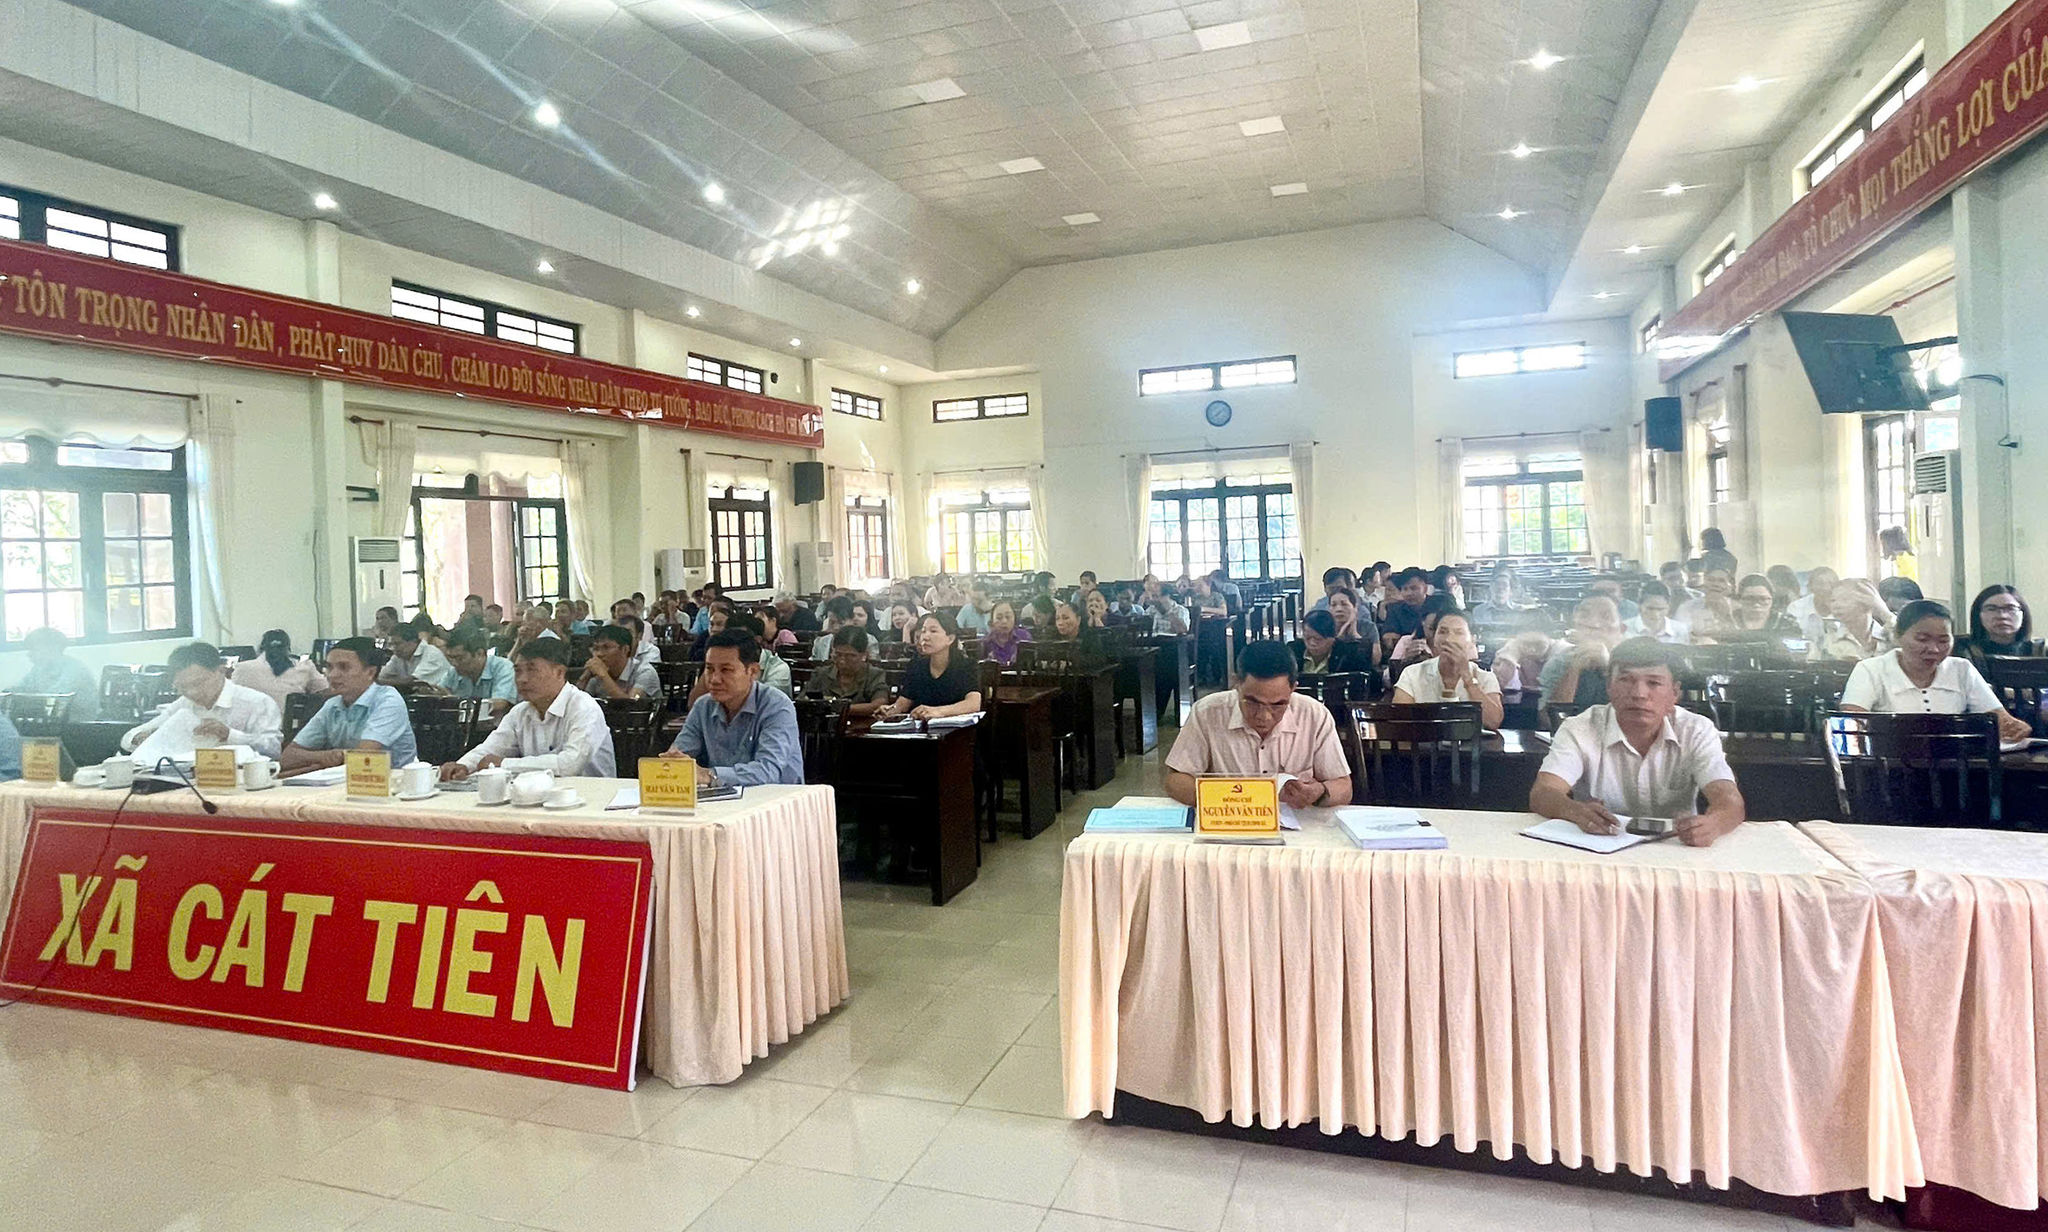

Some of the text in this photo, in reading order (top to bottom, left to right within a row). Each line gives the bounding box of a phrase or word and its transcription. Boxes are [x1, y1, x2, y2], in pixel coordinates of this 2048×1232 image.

[1860, 167, 1886, 221] MỌI
[1891, 113, 1950, 196] THẮNG
[1956, 78, 1995, 149] LỢI
[11, 268, 67, 319] TÔN
[75, 286, 160, 337] TRỌNG
[166, 302, 226, 344] NHÂN
[340, 334, 375, 368] HUY
[377, 337, 409, 374] DÂN
[493, 363, 509, 391] LO
[536, 363, 567, 399] SỐNG
[568, 375, 598, 403] NHÂN
[600, 379, 622, 408] DÂN
[623, 386, 649, 412] THEO
[1203, 804, 1235, 817] NGUYỄN
[1235, 804, 1253, 817] VĂN
[38, 854, 586, 1028] XÃ CÁT TIÊN
